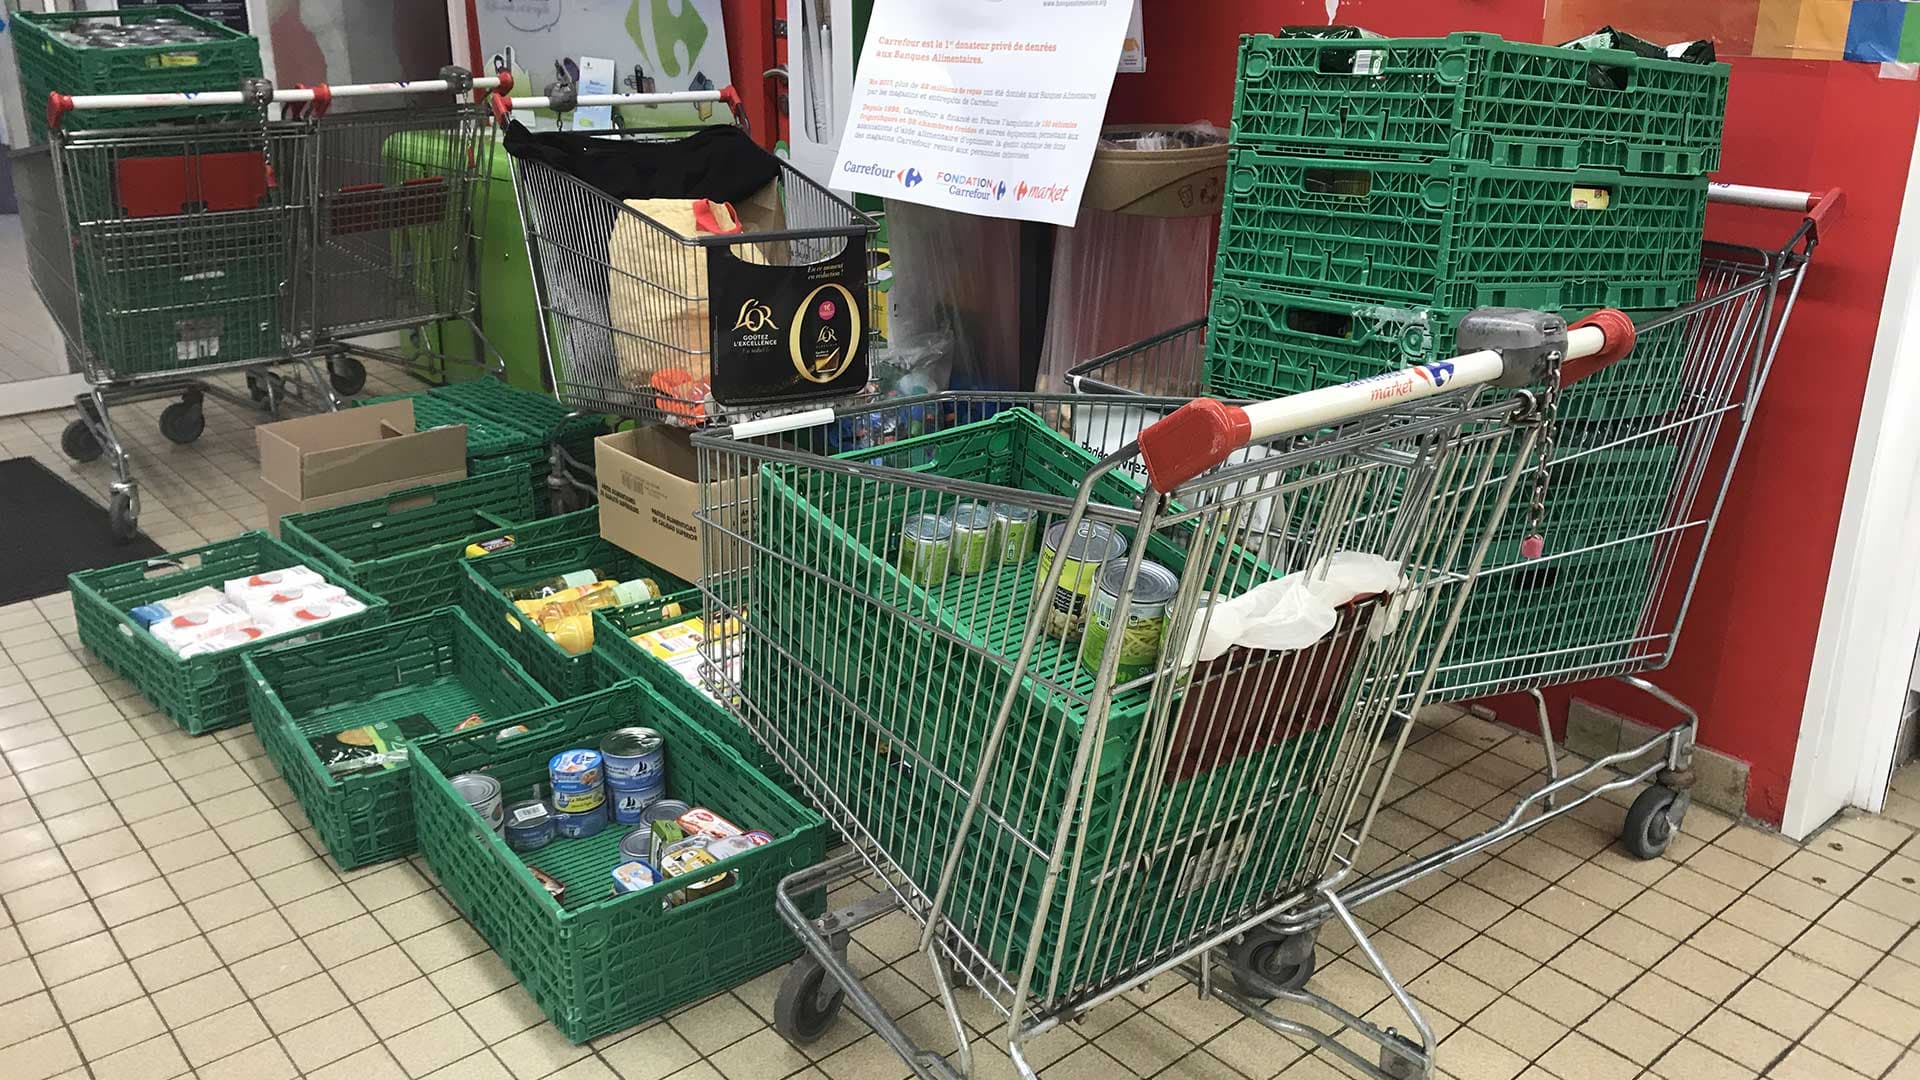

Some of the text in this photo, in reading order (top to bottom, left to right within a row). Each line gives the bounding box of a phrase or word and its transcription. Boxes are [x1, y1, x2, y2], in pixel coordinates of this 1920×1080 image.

[879, 36, 921, 48] Carrefour
[922, 40, 934, 49] est
[936, 40, 943, 49] le
[955, 41, 989, 50] donateur
[991, 41, 1012, 52] privé
[1013, 42, 1024, 51] de
[1025, 42, 1057, 52] denrées
[876, 50, 984, 64] aux Banques Alimentaires.
[904, 106, 939, 119] Carrefour
[896, 135, 932, 149] Carrefour
[843, 160, 896, 179] Carrefour
[936, 171, 994, 189] FONDATION
[948, 184, 992, 201] Carrefour
[1028, 181, 1070, 203] market
[823, 263, 844, 271] moment
[731, 298, 780, 332] L'OR
[817, 325, 838, 343] L'OR
[733, 339, 777, 347] L'EXCELLENCE
[1371, 378, 1414, 401] market
[676, 527, 698, 541] SUPERIOR
